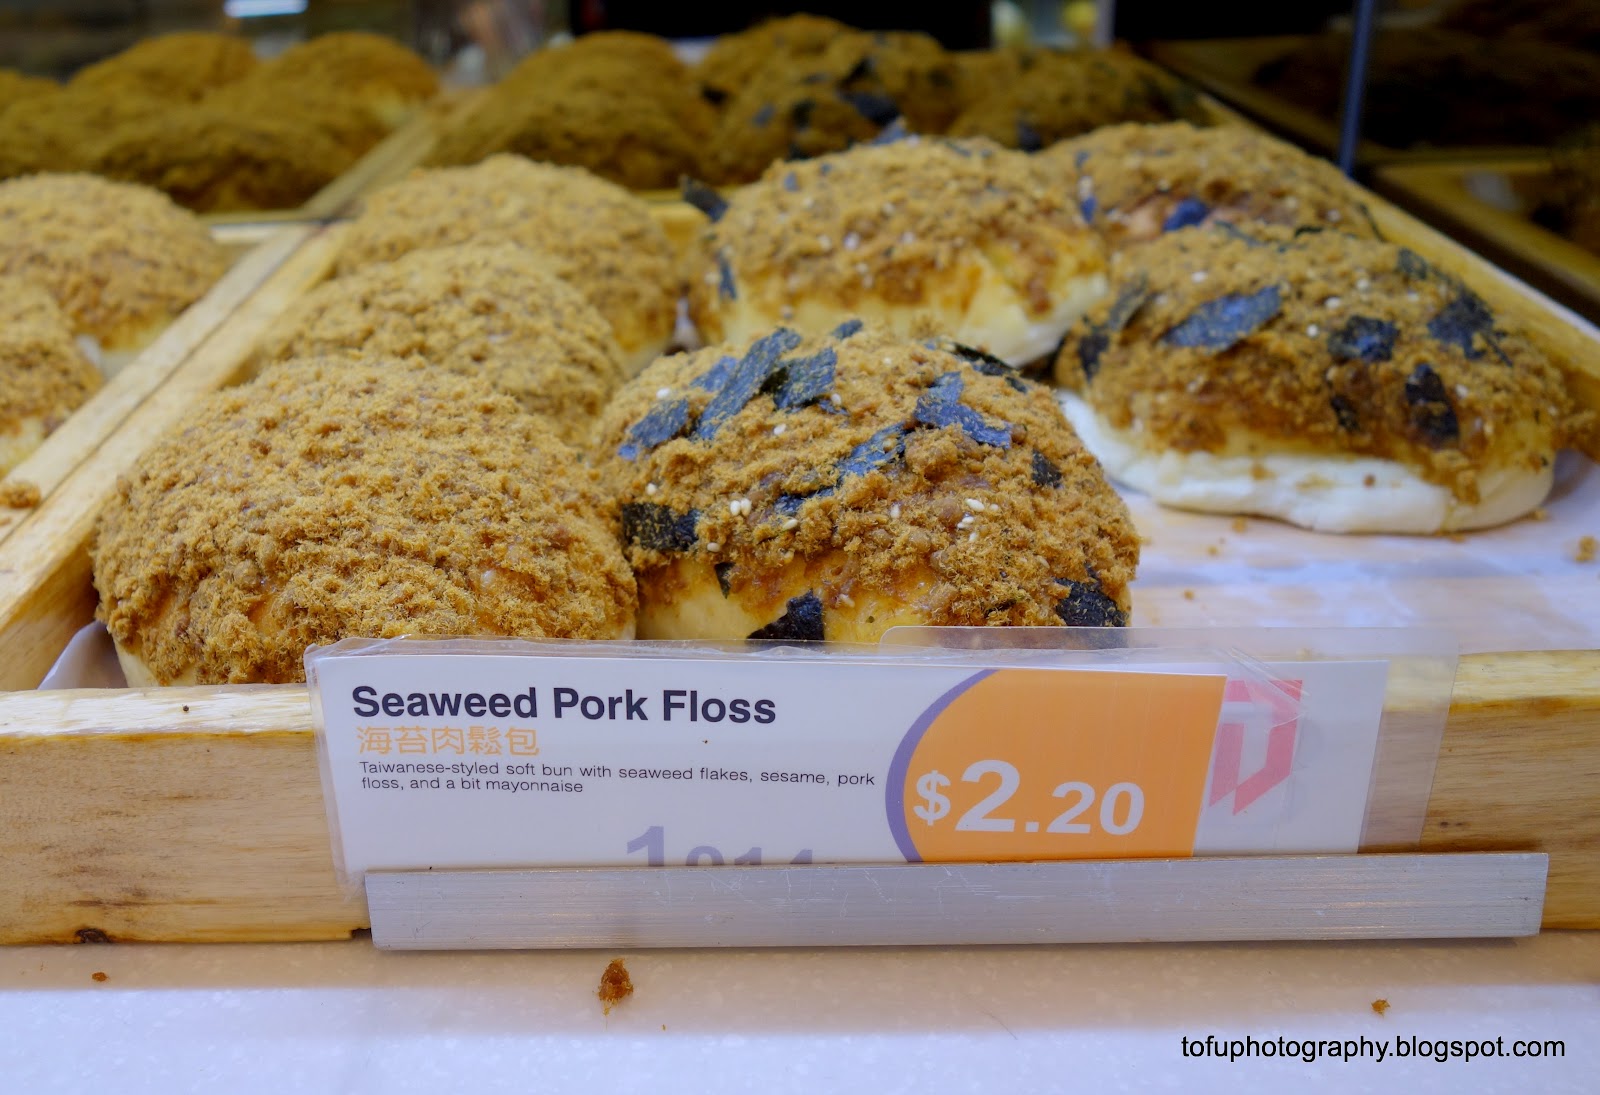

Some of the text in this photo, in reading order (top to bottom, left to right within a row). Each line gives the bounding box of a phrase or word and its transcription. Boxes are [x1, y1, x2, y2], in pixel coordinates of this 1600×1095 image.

[351, 685, 776, 724] Seaweed Pork Floss
[356, 725, 540, 756] 海苔肉鬆包
[359, 761, 875, 787] Taiwanese-styled soft bun with seaweed flakes, sesame, pork
[361, 777, 583, 793] floss, and a bit mayonnaise
[912, 759, 1145, 836] $2.20
